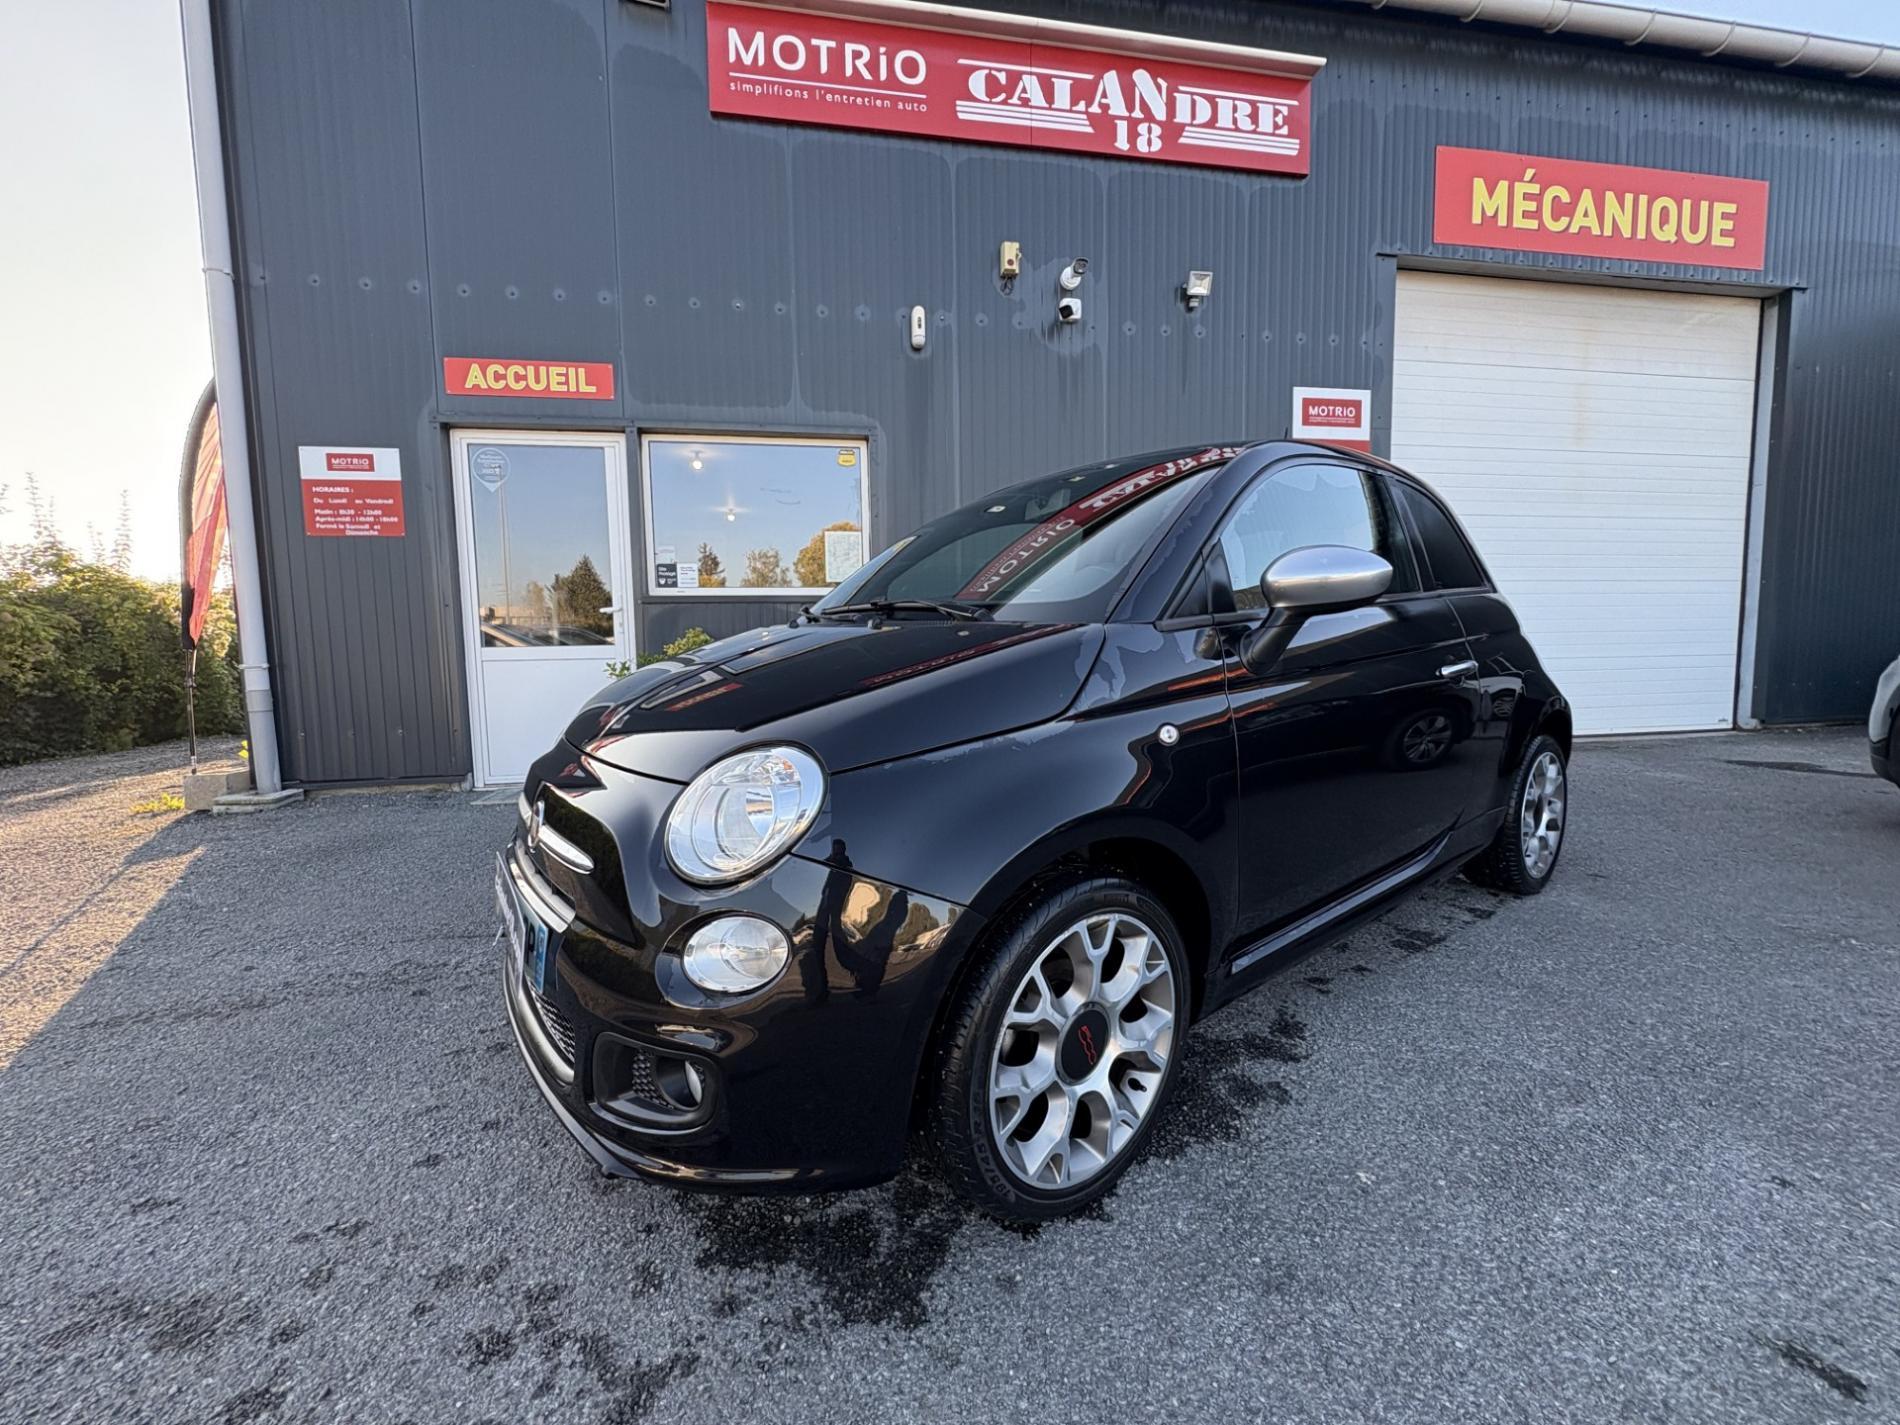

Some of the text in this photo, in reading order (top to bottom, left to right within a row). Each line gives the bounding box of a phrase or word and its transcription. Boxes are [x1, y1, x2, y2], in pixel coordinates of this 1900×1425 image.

[729, 80, 928, 112] simplifions l'entretien auto
[967, 68, 1289, 136] CALANDRE
[1114, 119, 1163, 153] 18
[1471, 168, 1738, 248] MÉCANIQUE
[464, 362, 598, 393] ACCUEIL
